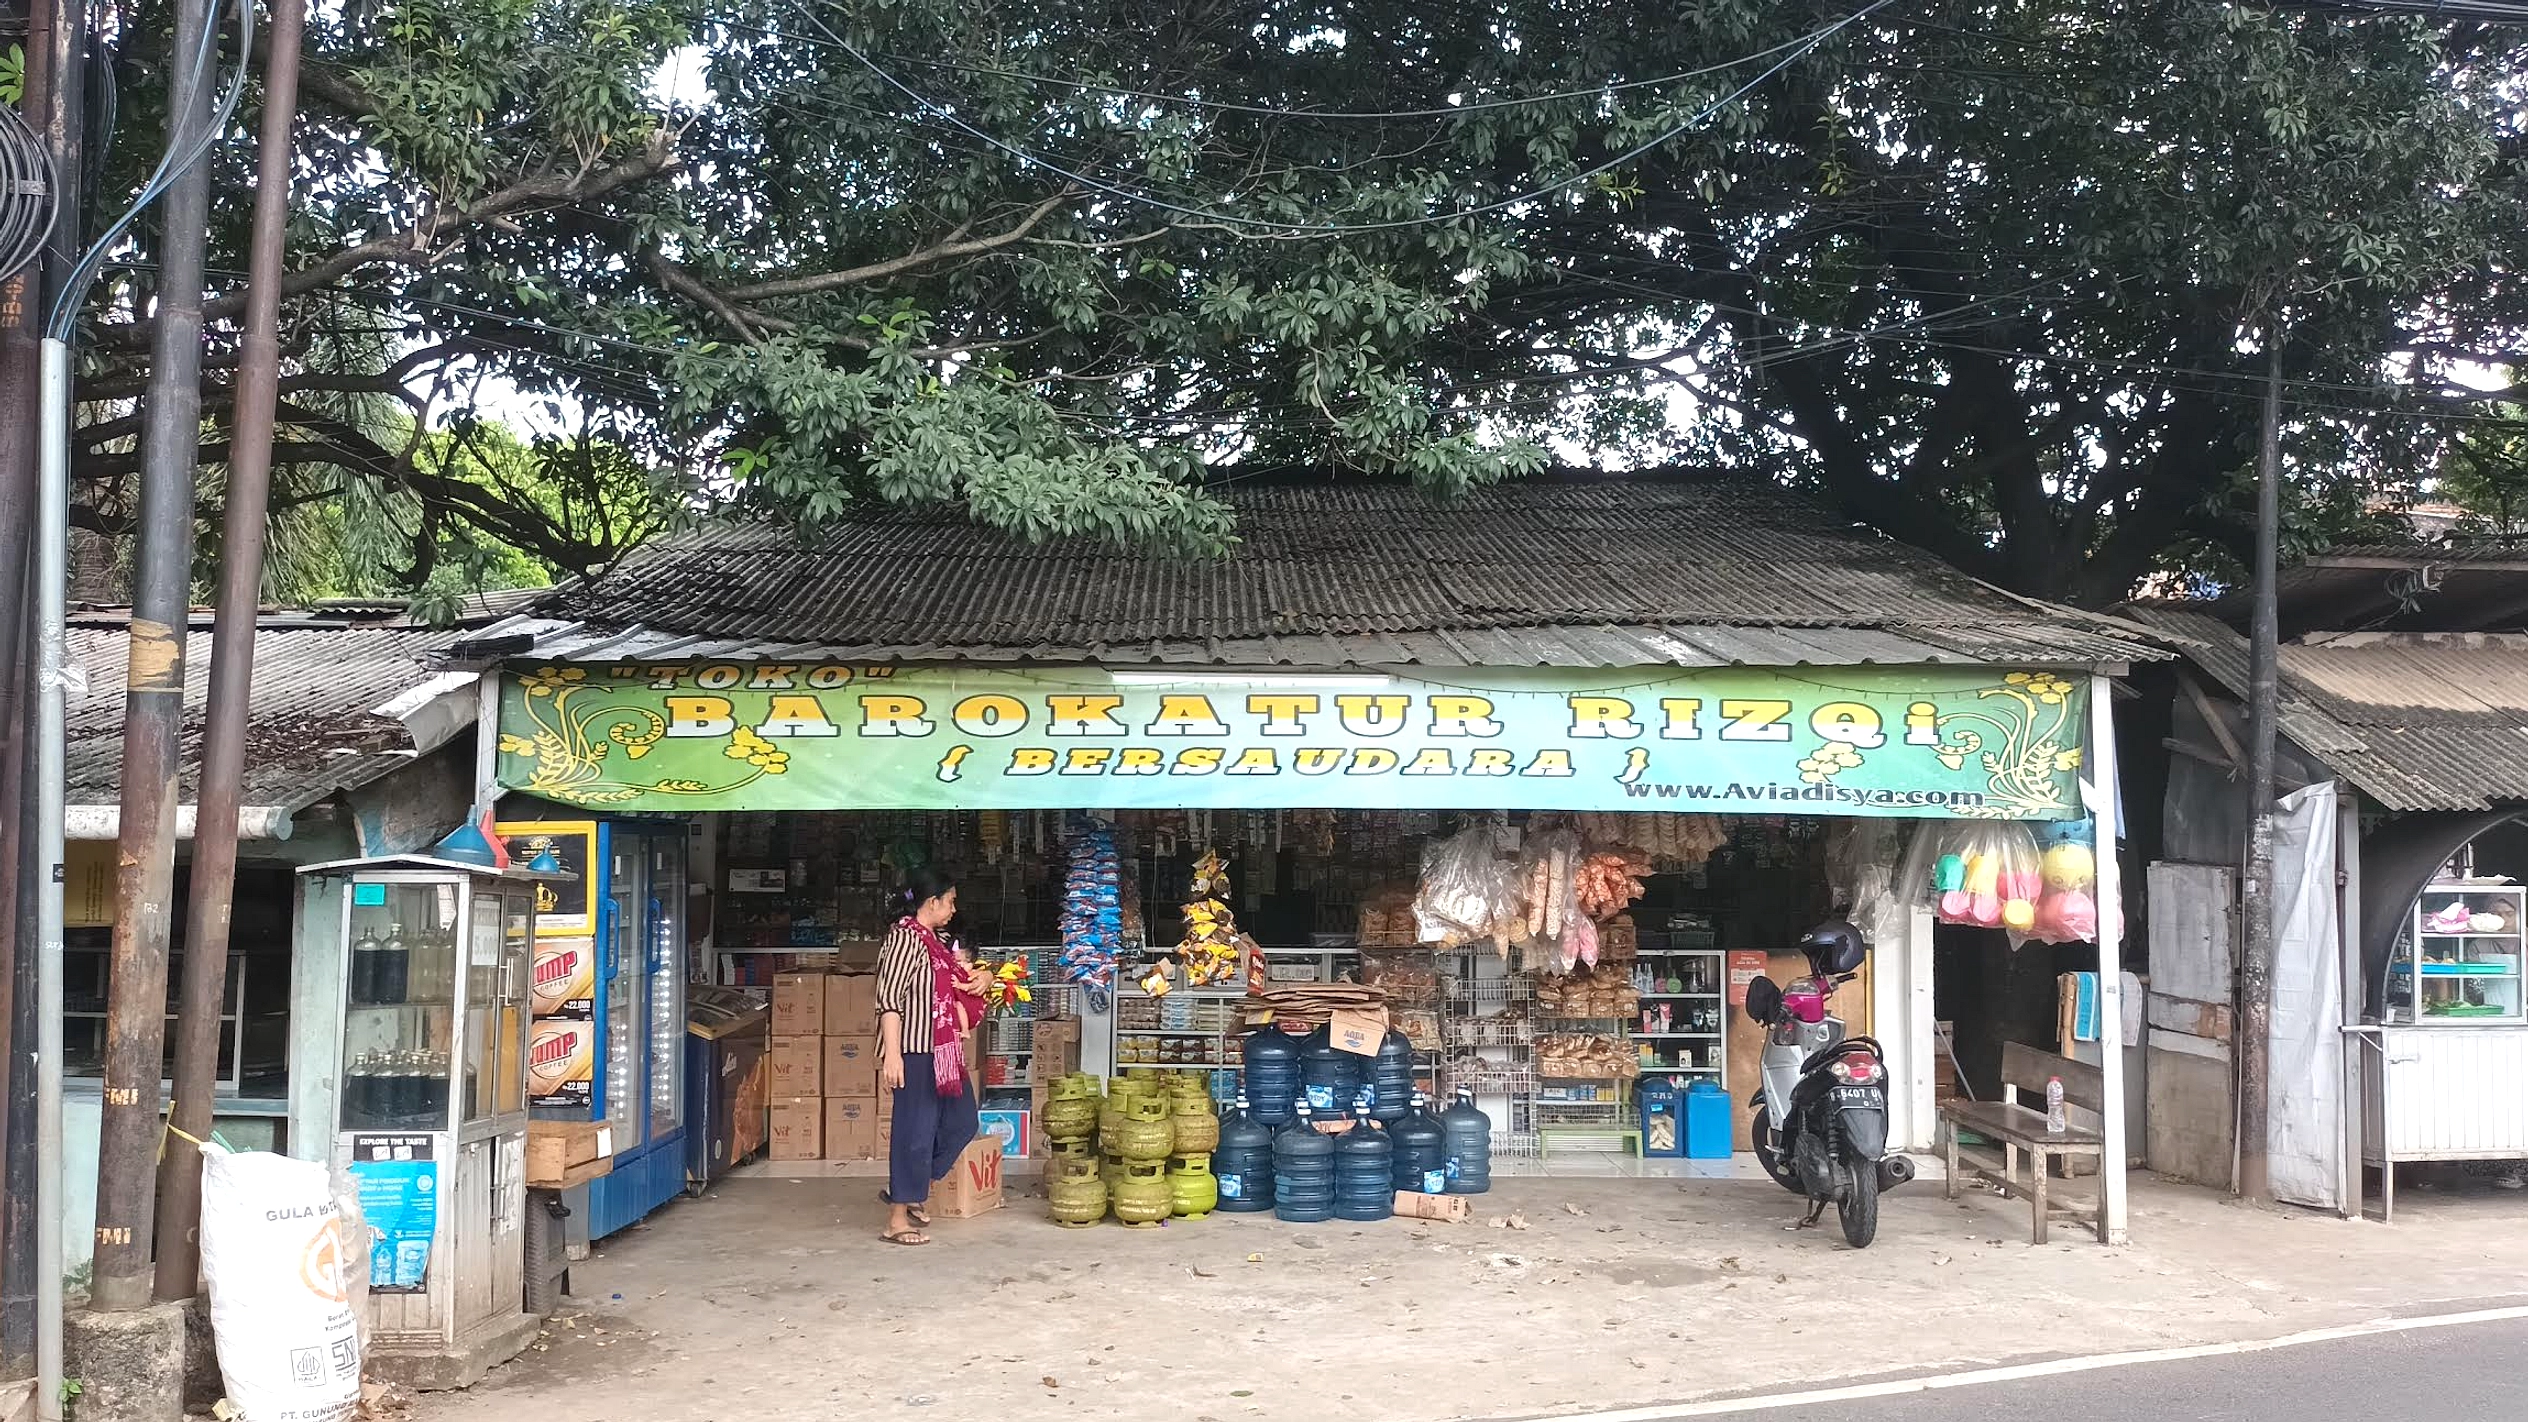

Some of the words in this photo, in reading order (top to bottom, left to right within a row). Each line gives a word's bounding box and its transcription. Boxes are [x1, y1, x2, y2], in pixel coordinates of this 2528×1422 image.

[608, 663, 897, 690] "TOKO"
[664, 694, 1505, 738] BAROKATUR
[1003, 747, 1577, 778] BERSAUDARA
[1624, 782, 1986, 809] www.Aviadisya.com
[405, 1137, 428, 1145] TASTE
[968, 1149, 1003, 1192] Vit
[266, 1206, 314, 1221] GULA
